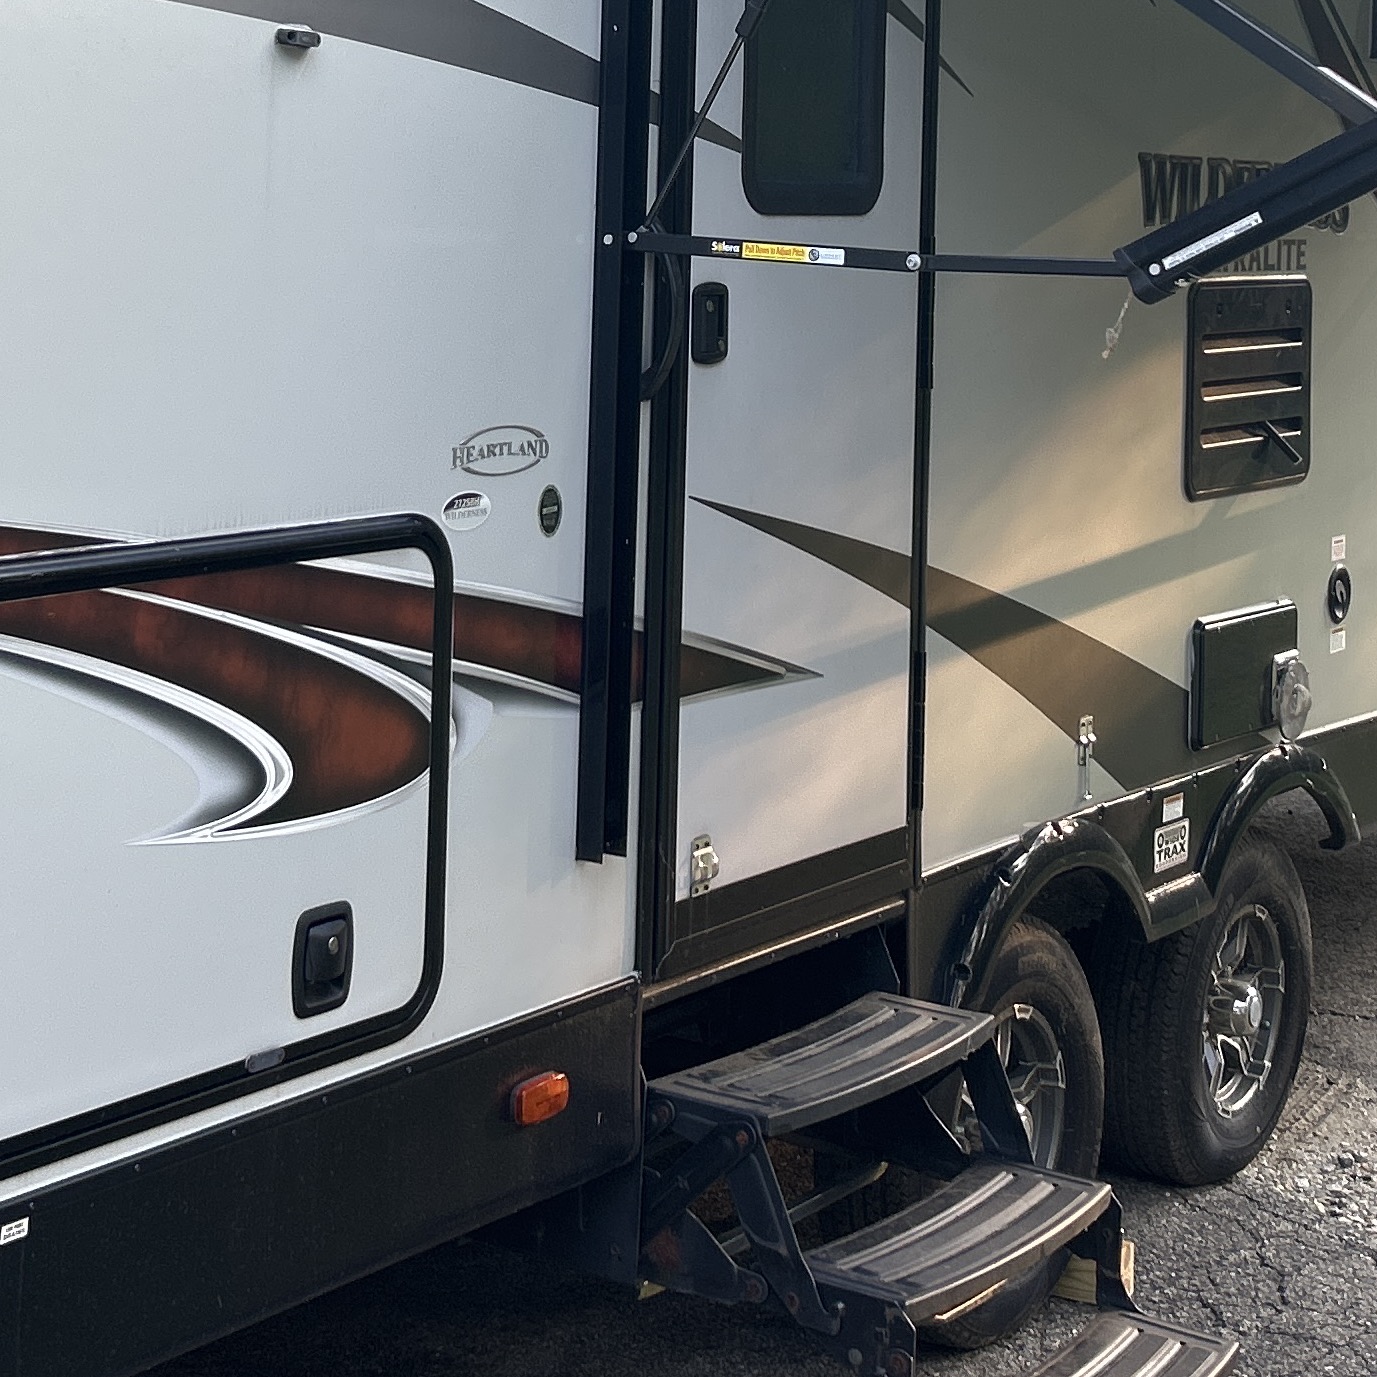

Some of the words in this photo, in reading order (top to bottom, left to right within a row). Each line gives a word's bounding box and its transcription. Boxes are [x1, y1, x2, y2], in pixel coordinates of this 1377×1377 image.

[711, 240, 740, 253] Solera
[450, 438, 550, 471] HEARTLAND
[1156, 840, 1186, 862] TRAX
